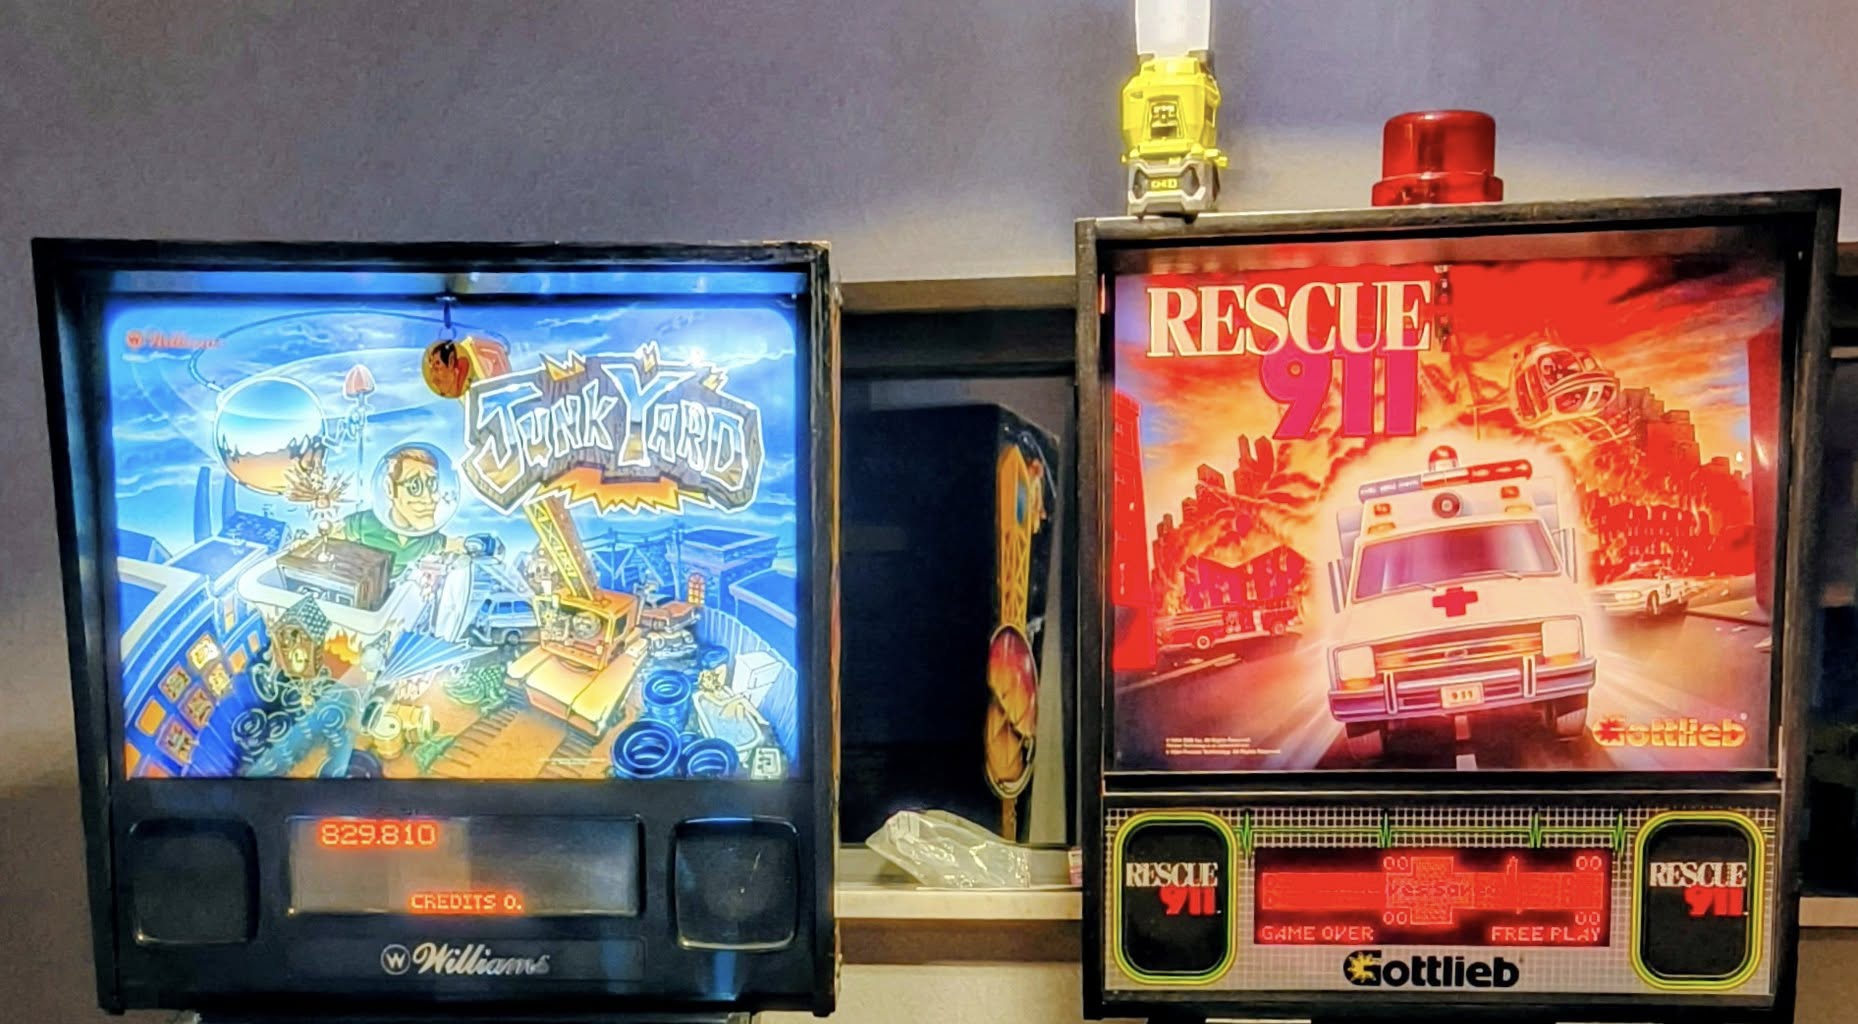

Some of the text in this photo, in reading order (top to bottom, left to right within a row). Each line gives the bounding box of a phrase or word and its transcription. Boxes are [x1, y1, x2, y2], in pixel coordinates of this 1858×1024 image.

[1146, 281, 1431, 358] RESCUE
[1259, 340, 1418, 440] 911
[1592, 714, 1746, 747] Gottlieb
[320, 823, 437, 846] 829.810
[1125, 862, 1218, 888] RESCUE
[1649, 862, 1747, 888] RESCUE
[410, 893, 497, 911] CREDITS
[1262, 926, 1374, 941] GAME OVER
[1491, 926, 1600, 941] FREE PLAY
[412, 942, 550, 975] Williams
[1343, 949, 1520, 987] Gottlieb
